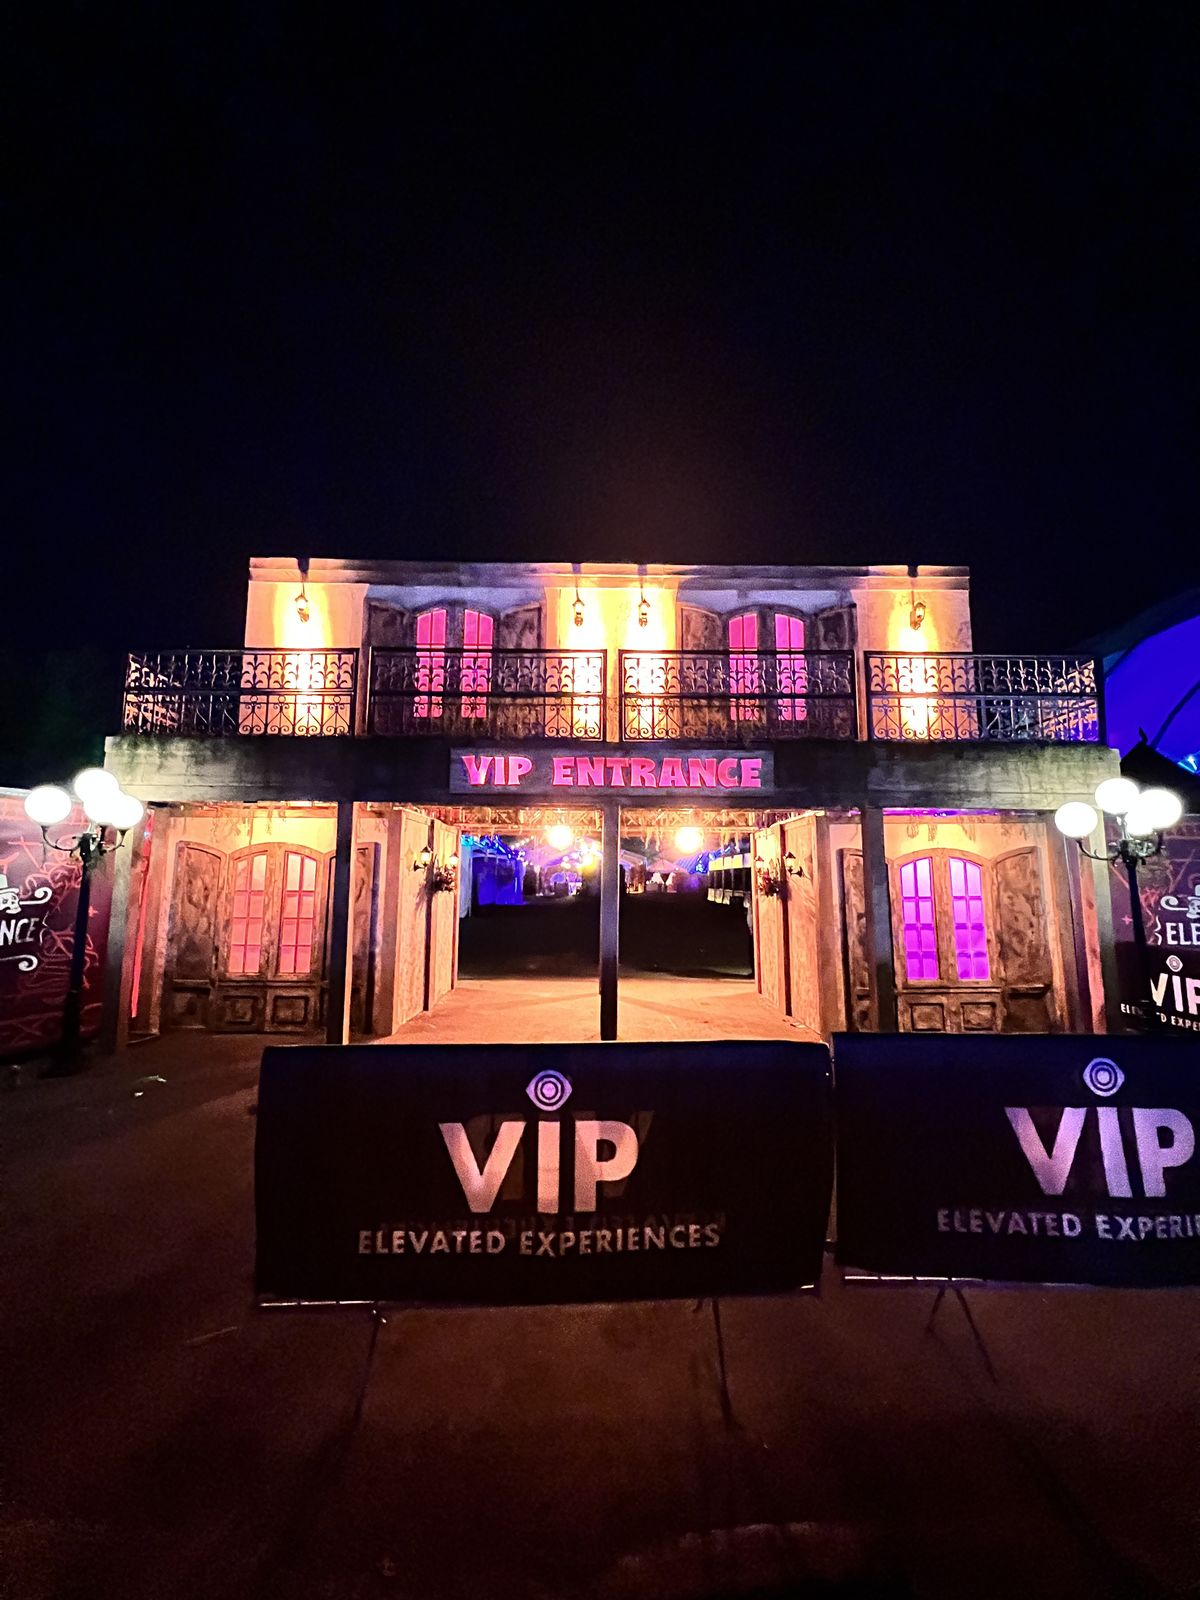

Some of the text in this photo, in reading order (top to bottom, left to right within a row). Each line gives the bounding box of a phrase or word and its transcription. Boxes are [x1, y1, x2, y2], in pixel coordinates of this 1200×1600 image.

[462, 755, 762, 788] VIP ENTRANCE
[438, 1119, 639, 1214] VIP
[1004, 1106, 1195, 1198] VIP
[937, 1208, 1082, 1237] ELEVATED
[357, 1223, 720, 1257] ELEVATED EXPERIENCES
